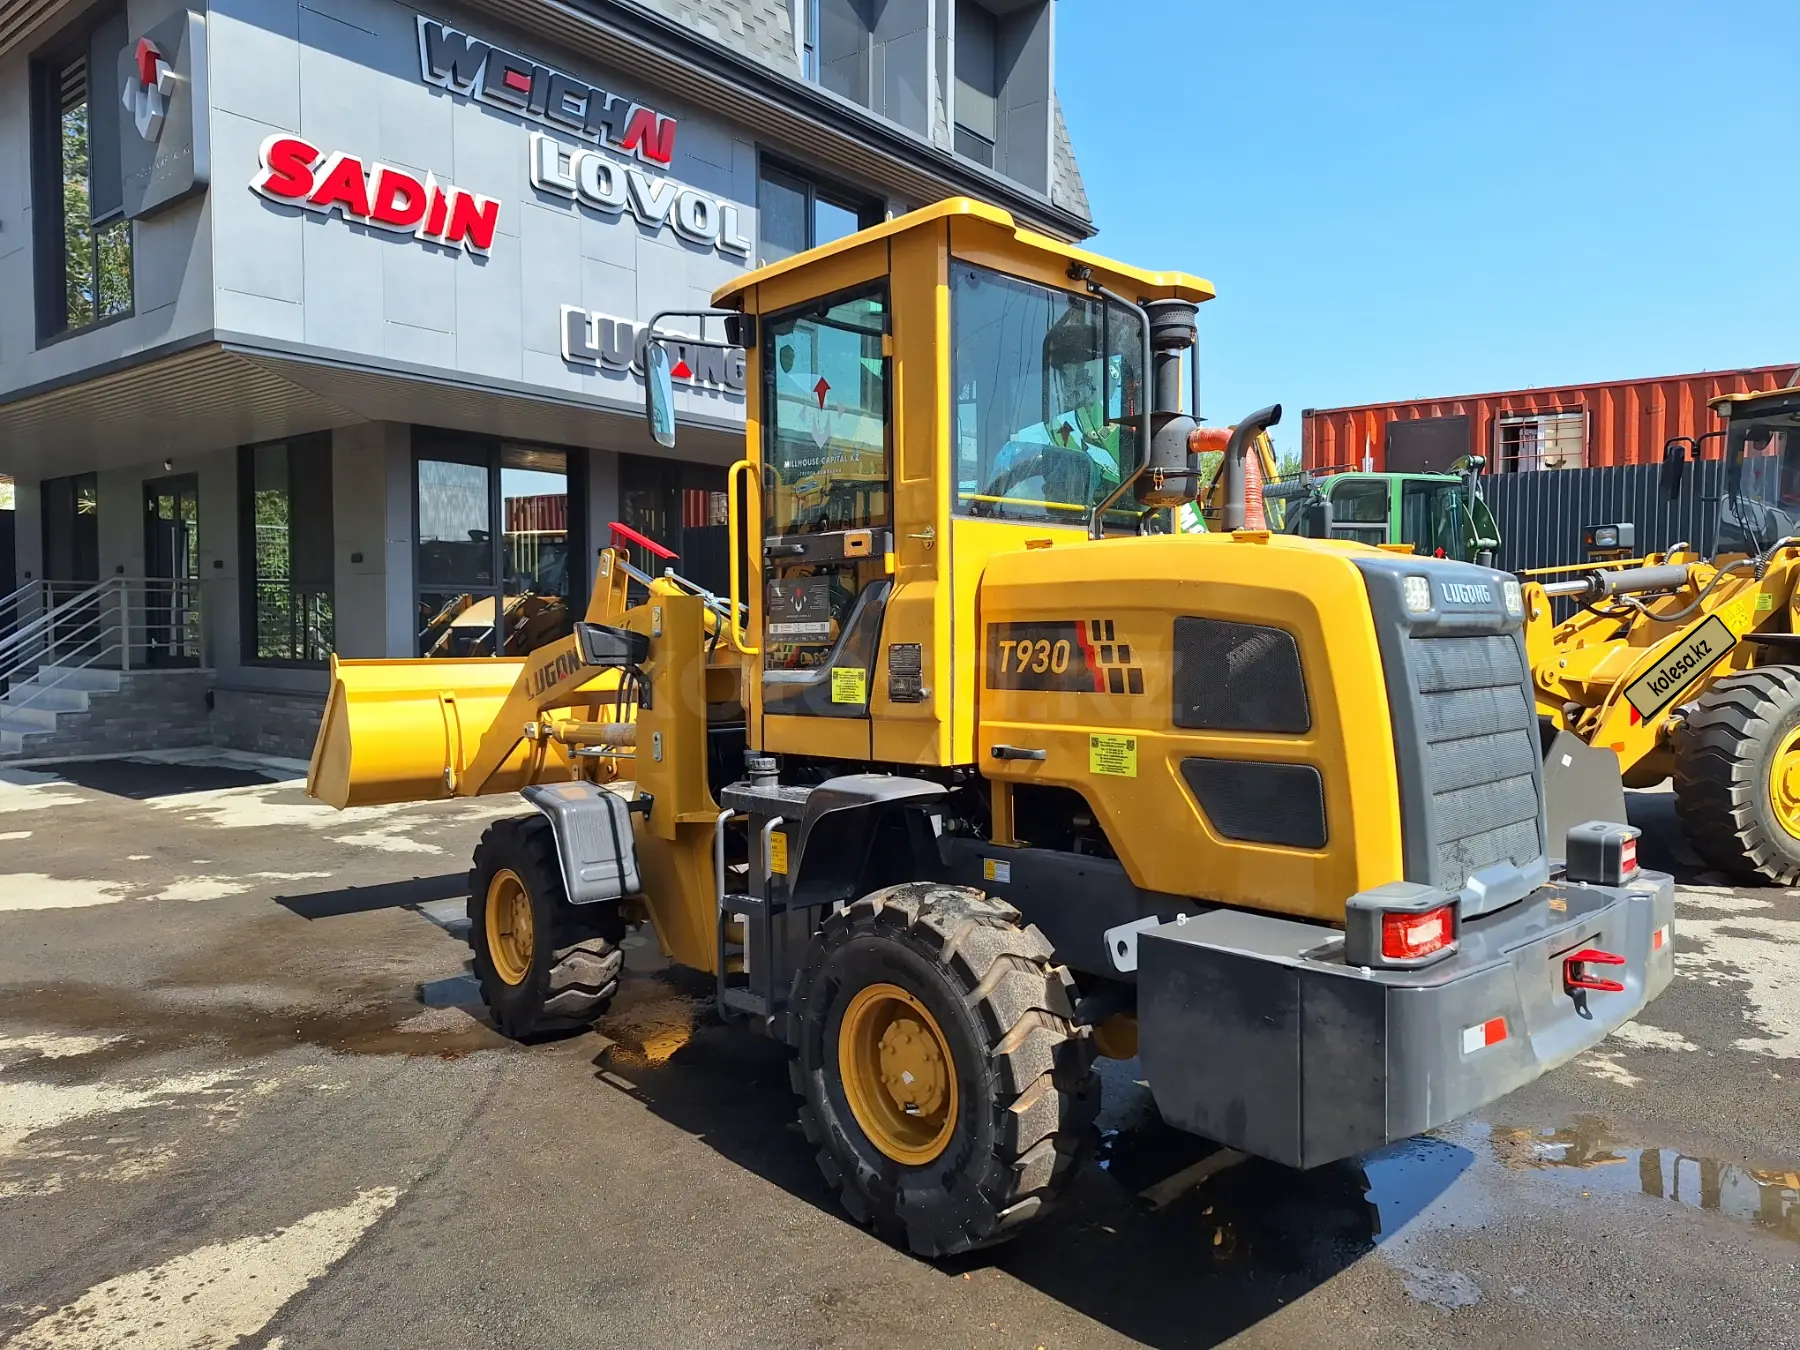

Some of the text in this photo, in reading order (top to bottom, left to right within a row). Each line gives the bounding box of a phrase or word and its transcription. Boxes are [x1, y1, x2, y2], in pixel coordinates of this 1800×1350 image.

[418, 17, 677, 168] WEICHAI
[253, 135, 500, 255] SADIN
[531, 134, 751, 256] LOVOL
[784, 456, 819, 468] MILLHOUSE
[820, 454, 847, 465] CAPITAL
[1440, 583, 1492, 605] LUGONG
[525, 645, 584, 701] LUGON
[1000, 639, 1071, 674] T930
